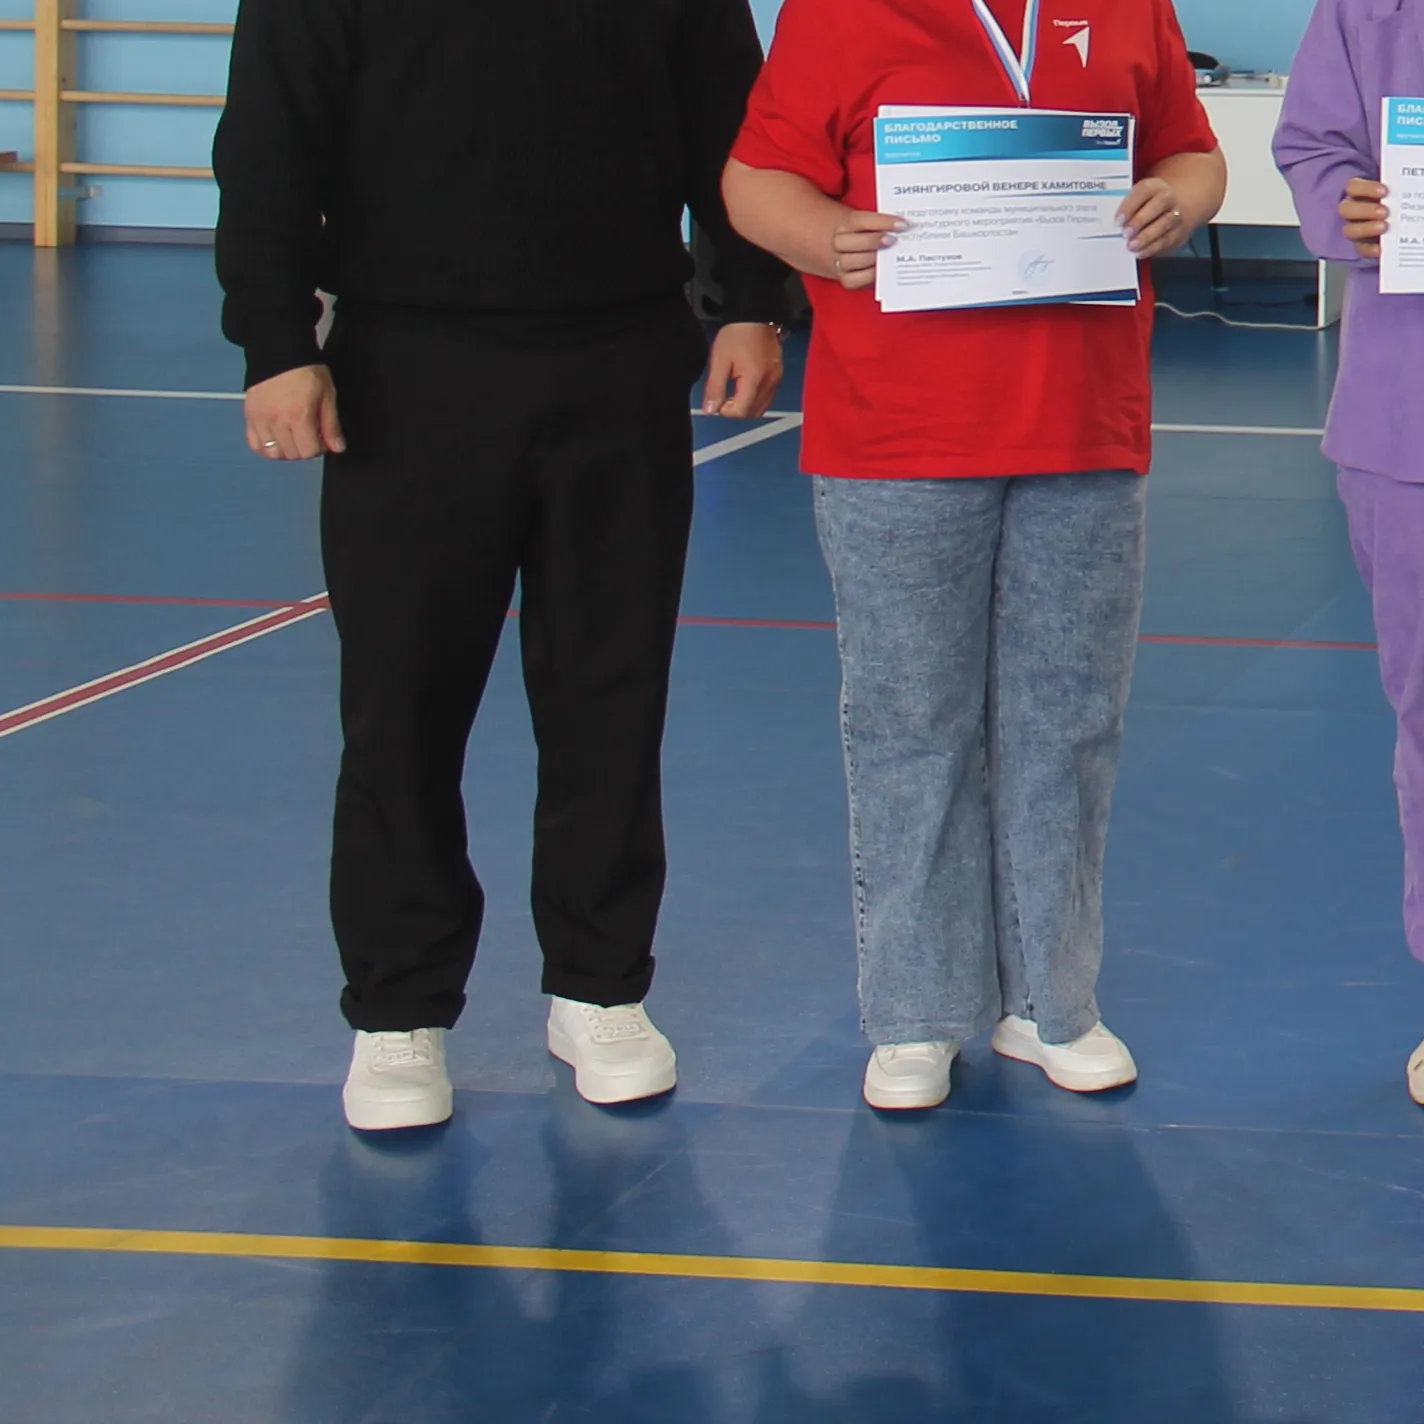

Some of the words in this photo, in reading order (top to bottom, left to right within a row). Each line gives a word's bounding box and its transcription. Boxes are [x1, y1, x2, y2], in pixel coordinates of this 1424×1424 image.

[883, 119, 1017, 133] БЛАГОДАРСТВЕННОЕ
[1083, 119, 1118, 128] ВЫЗОВ
[1081, 126, 1123, 137] ПЕРВЫХ
[884, 134, 941, 144] ПИСЬМО
[893, 181, 989, 195] ЗИЯНГИРОВОЙ
[992, 181, 1038, 191] ВЕНЕРЕ
[1040, 181, 1106, 190] ХАМИТОВНЕ
